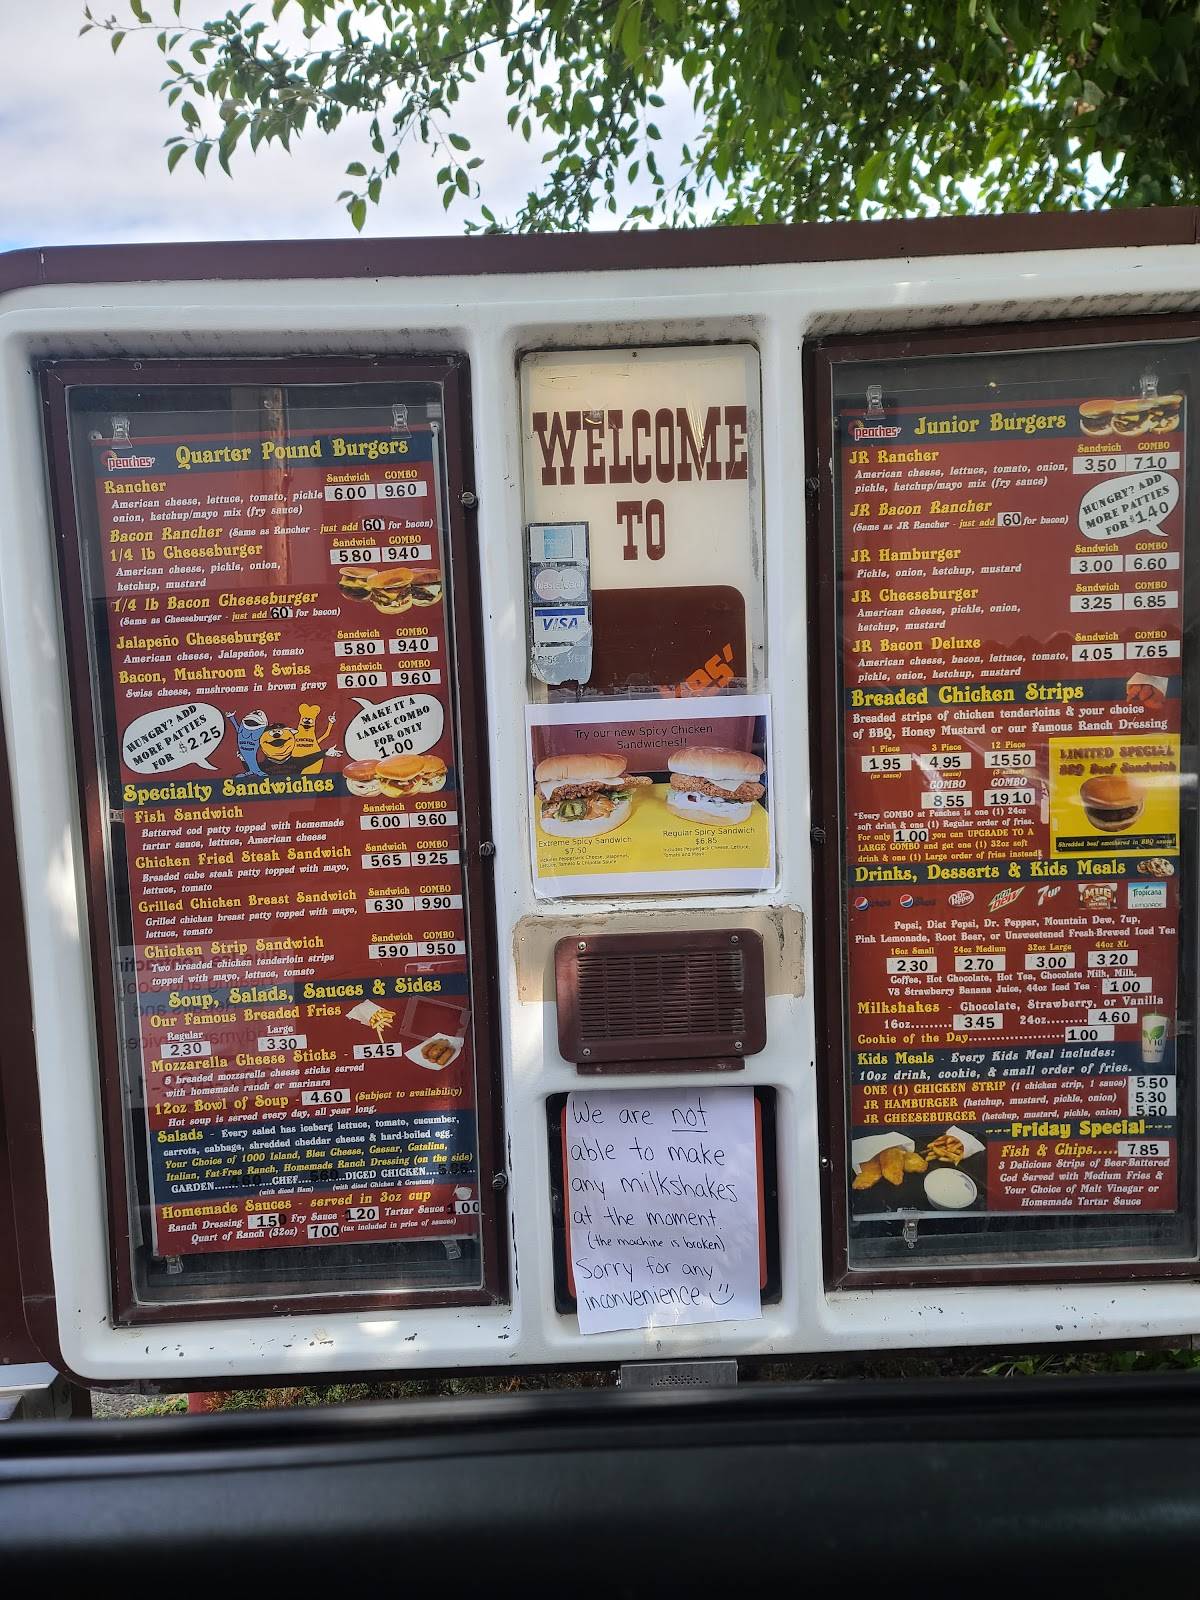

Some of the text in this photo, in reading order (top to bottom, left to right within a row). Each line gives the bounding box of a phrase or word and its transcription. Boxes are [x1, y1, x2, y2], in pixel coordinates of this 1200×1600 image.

[914, 412, 1066, 435] Junior Burgers
[176, 438, 408, 470] Quarter Pound Burgers
[532, 406, 748, 485] WELCOME
[1078, 441, 1169, 453] Sandwich COMBO
[849, 449, 939, 464] JR Rancher
[326, 470, 417, 482] Sandwich COMBO
[104, 480, 166, 494] Rancher
[112, 498, 160, 509] American
[165, 497, 201, 507] cheese,
[207, 494, 244, 505] lettuce,
[249, 491, 287, 503] tomato,
[112, 504, 303, 523] onion, ketchup/mayo mix (fry sauce)
[616, 499, 666, 560] TO
[110, 543, 263, 562] 1/4 lb Cheeseburger
[851, 547, 961, 562] JR Hamburger
[857, 563, 1021, 579] Pickle, onion, ketchup, mustard
[117, 578, 206, 592] ketchup, mustard
[543, 617, 578, 630] VISA
[186, 630, 281, 646] Cheeseburger
[852, 636, 981, 653] JR Bacon Deluxe
[119, 663, 311, 684] Bacon, Mushroom & Swiss
[852, 683, 1084, 707] Breaded Chicken Strips
[361, 697, 415, 724] MAKE IT A
[853, 704, 1144, 724] Breaded strips of chicken tenderloins & your choice
[126, 705, 196, 752] HUNGRY? ADD
[357, 705, 429, 740] LARGE COMBO
[575, 724, 713, 740] Try our new Spicy Chicken
[132, 714, 207, 765] MORE PATTIES
[374, 722, 422, 747] FOR ONLY
[152, 753, 175, 770] FOR
[123, 776, 334, 805] Specialty Sandwiches
[134, 806, 243, 823] Fish Sandwich
[539, 836, 632, 847] Extreme Spicy Sandwich
[663, 827, 755, 838] Regular Spicy Sandwich
[135, 846, 352, 870] Chicken Fried Steak Sandwich
[855, 859, 1126, 883] Drinks, Desserts & Kids Meals
[144, 935, 324, 959] Chicken Strip Sandwich
[168, 977, 442, 1010] Soup, Salads, Sauces & Sides
[151, 1004, 342, 1028] Our Famous Breaded Fries
[857, 1001, 940, 1015] Milkshakes
[167, 1024, 293, 1042] Regular Large
[155, 1095, 289, 1116] 12oz Bowl of Soup
[573, 1097, 709, 1127] We are not
[1012, 1119, 1144, 1138] Friday Special
[571, 1136, 724, 1165] able to make
[572, 1171, 738, 1203] any milkshakes
[1021, 1195, 1141, 1207] Homemade Tartar Sauce
[574, 1206, 592, 1224] at
[604, 1206, 634, 1225] the
[587, 1231, 726, 1252] (the machine is broken)
[576, 1256, 714, 1282] Sorry for any
[582, 1285, 700, 1311] inconvenience
